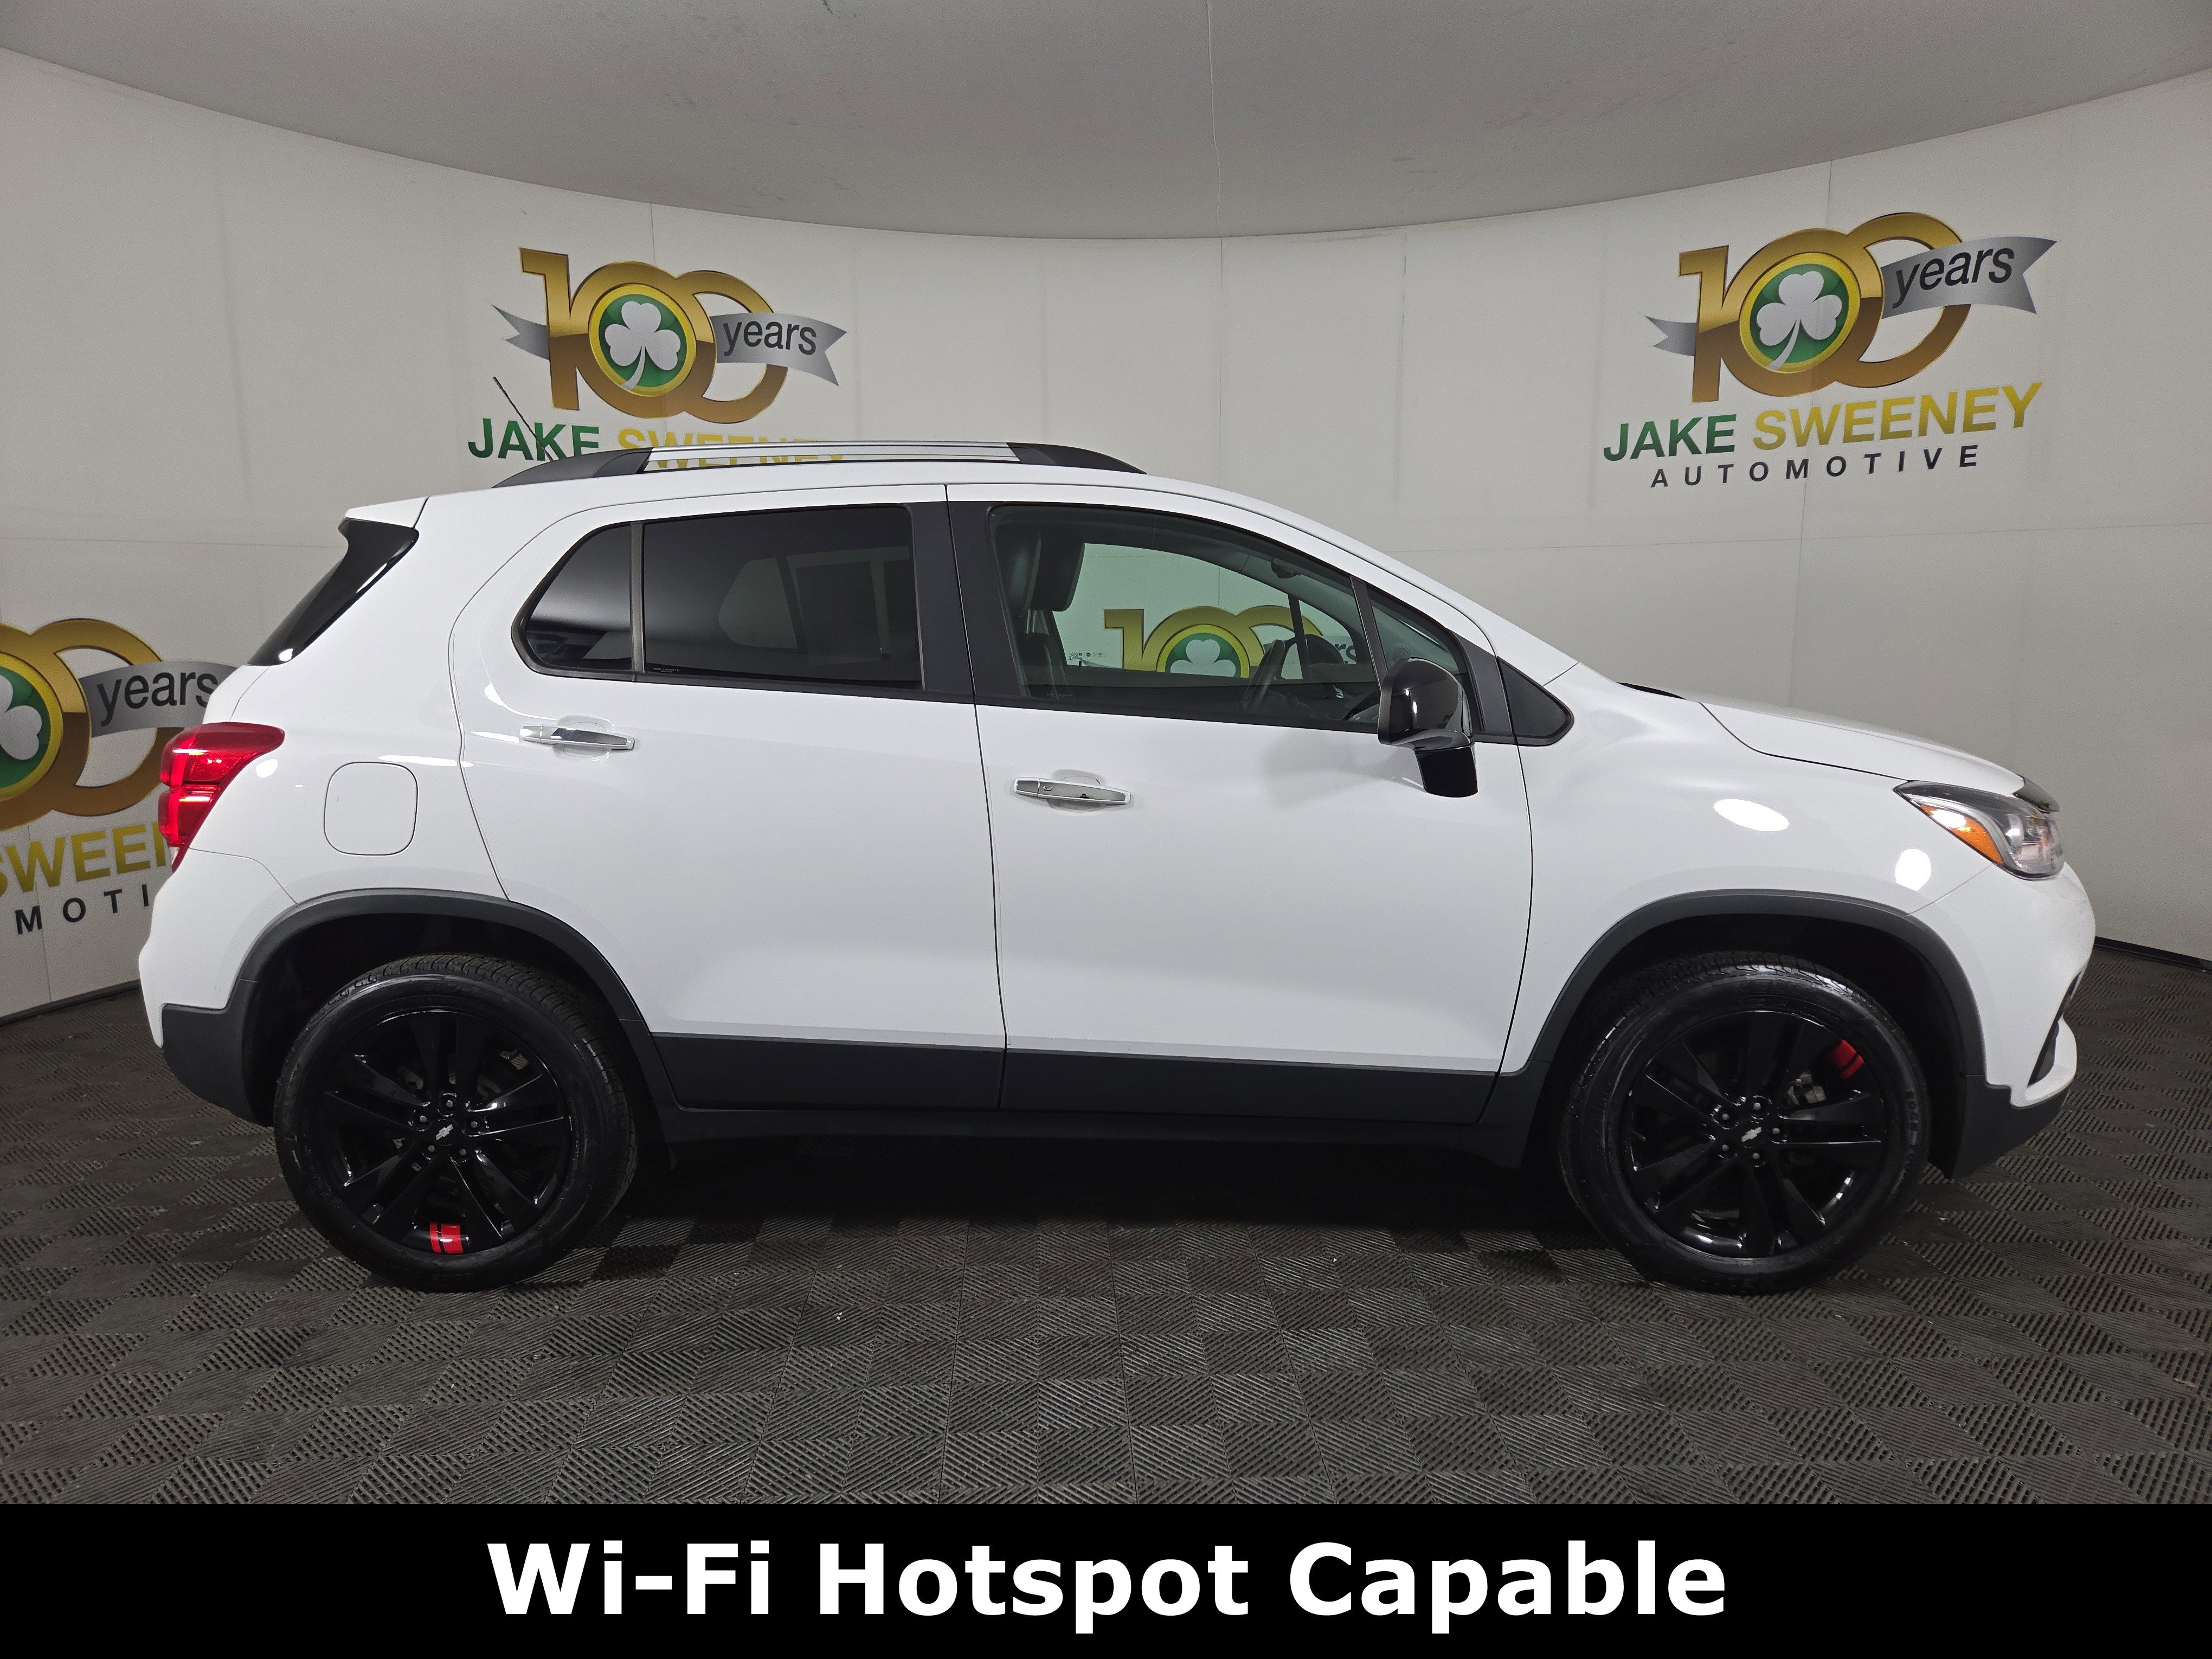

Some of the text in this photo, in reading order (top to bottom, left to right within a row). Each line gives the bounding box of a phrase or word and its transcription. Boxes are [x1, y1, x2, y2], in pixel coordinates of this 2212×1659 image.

[520, 247, 817, 424] 100 years
[1679, 211, 2015, 403] 100 years
[468, 418, 600, 461] JAKE
[1603, 381, 2044, 461] JAKE SWEENEY
[1650, 444, 1979, 488] AUTOMOTIVE
[97, 671, 218, 726] years
[0, 822, 166, 897] WEE
